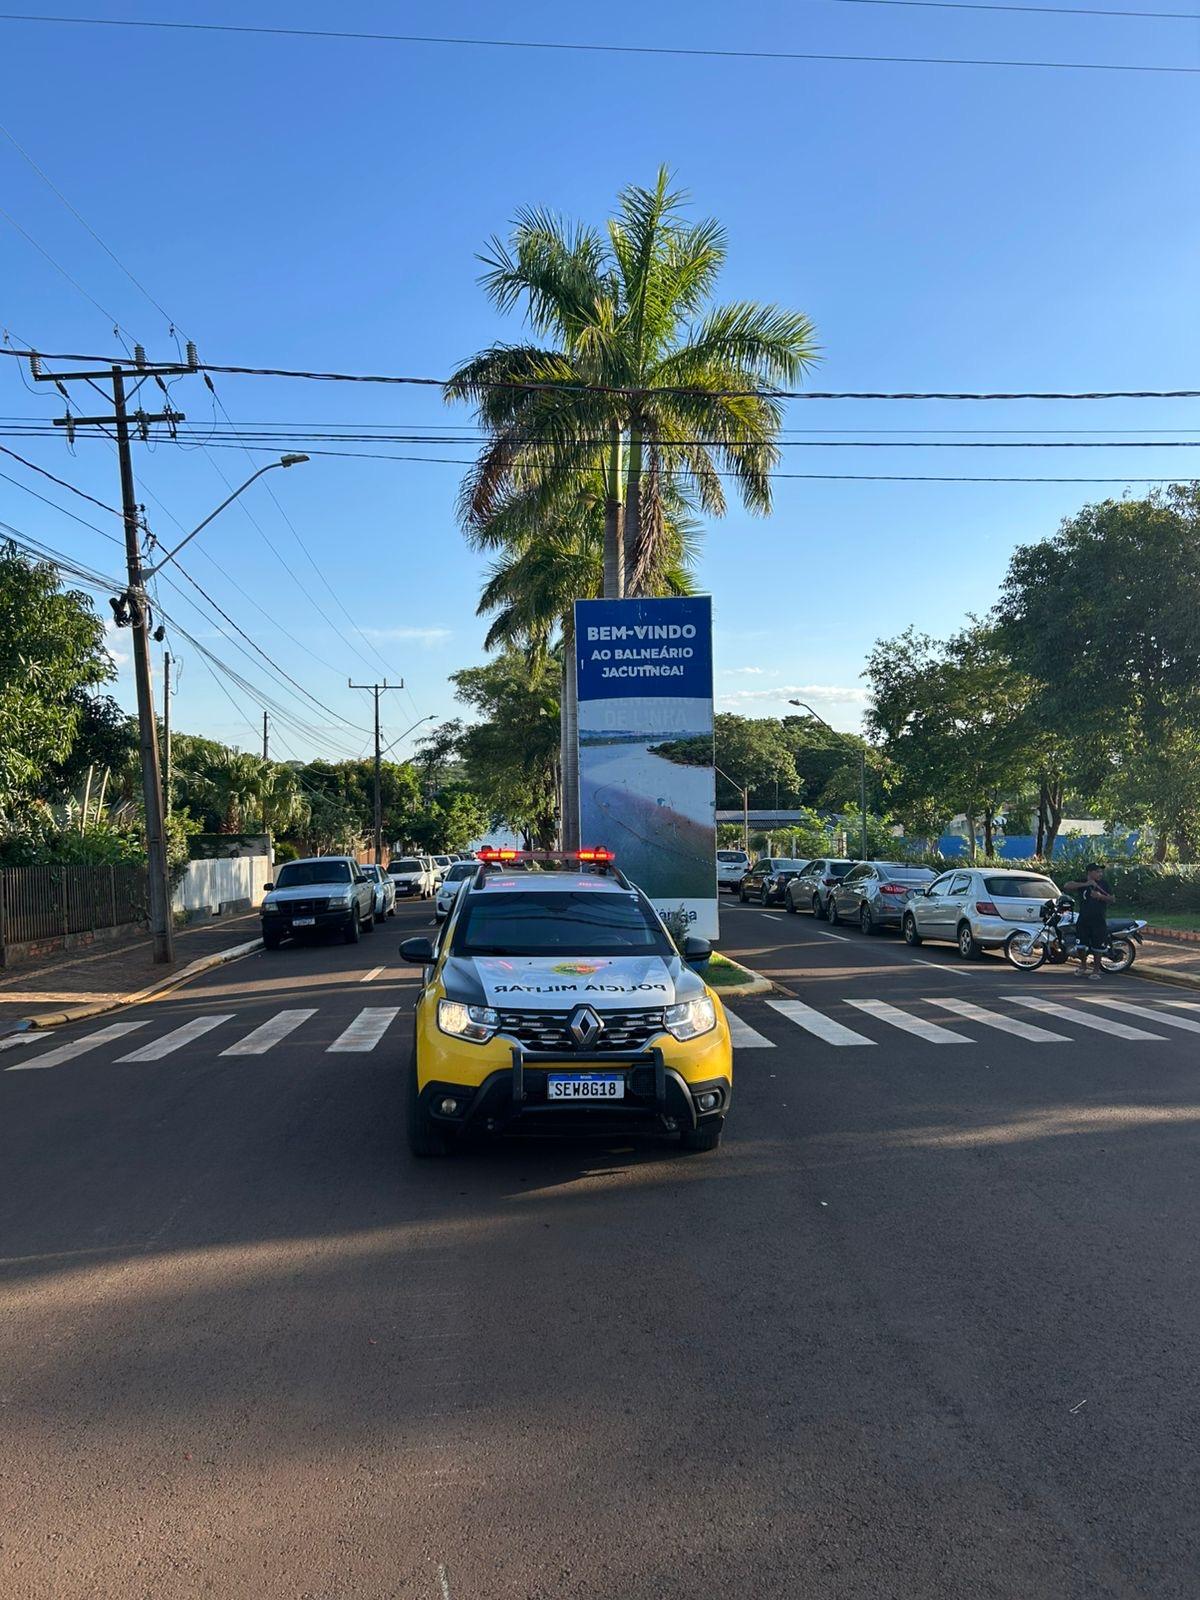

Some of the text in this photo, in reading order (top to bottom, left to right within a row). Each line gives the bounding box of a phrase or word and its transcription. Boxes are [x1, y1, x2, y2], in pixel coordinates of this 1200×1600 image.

[587, 624, 697, 641] BEM-VINDO
[591, 645, 694, 660] AO BALNEÁRIO
[555, 1082, 616, 1096] SEW8G18
